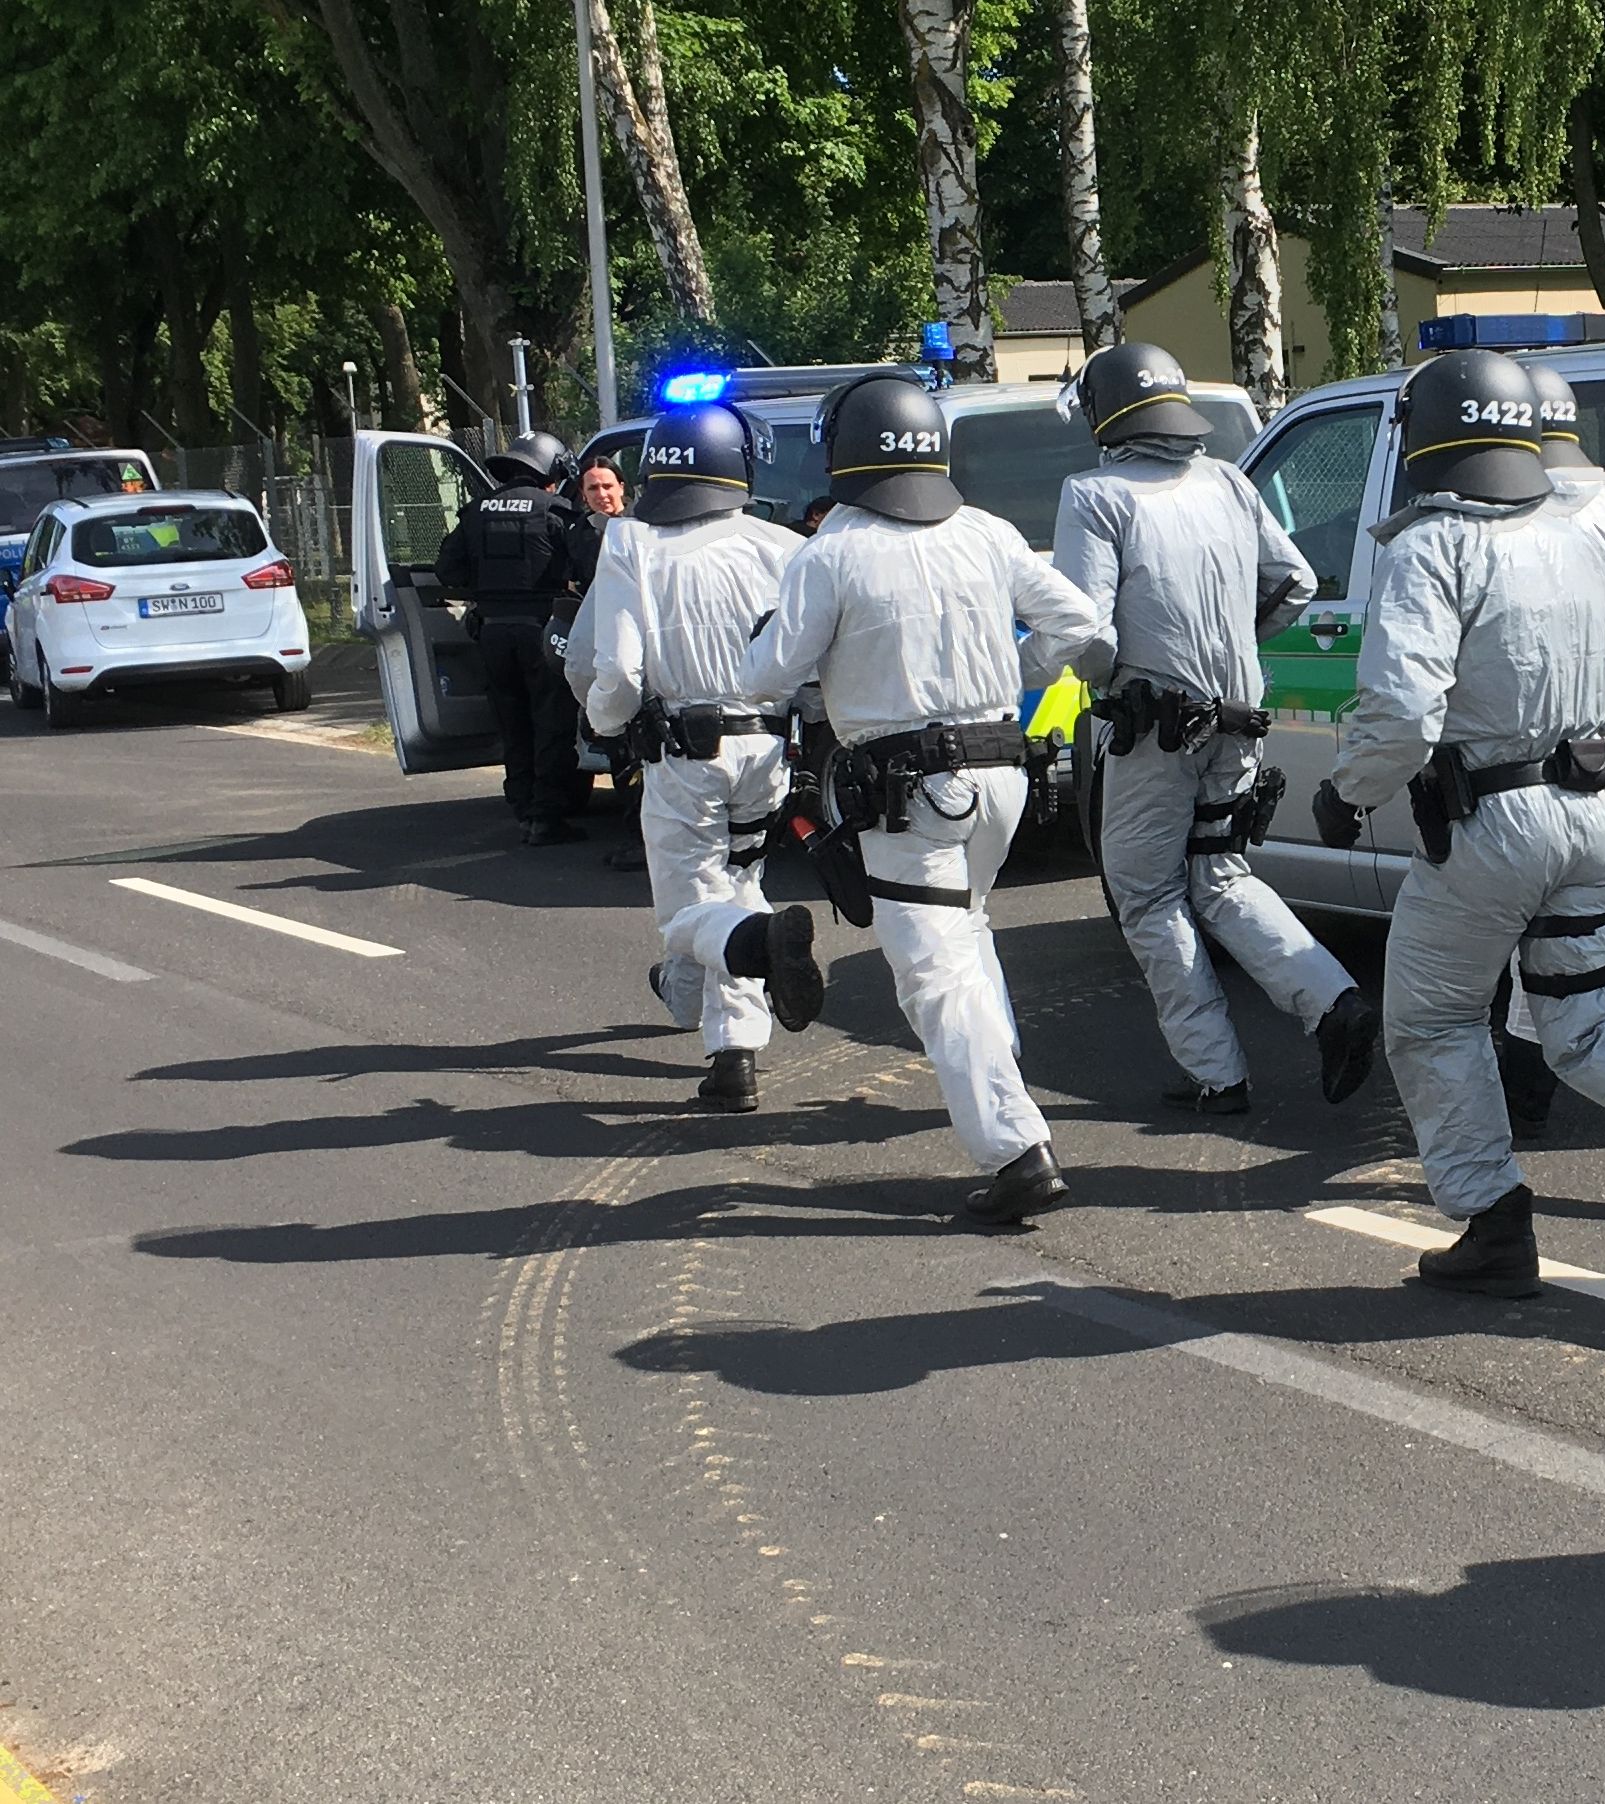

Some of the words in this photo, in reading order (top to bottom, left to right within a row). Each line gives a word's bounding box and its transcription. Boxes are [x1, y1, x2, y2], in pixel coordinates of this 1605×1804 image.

[1461, 399, 1533, 427] 3422
[1540, 400, 1577, 421] 422
[880, 431, 941, 452] 3421
[648, 446, 695, 465] 3421
[480, 499, 533, 512] POLIZEI
[152, 598, 170, 613] SW
[178, 597, 188, 610] N
[191, 596, 217, 610] 100
